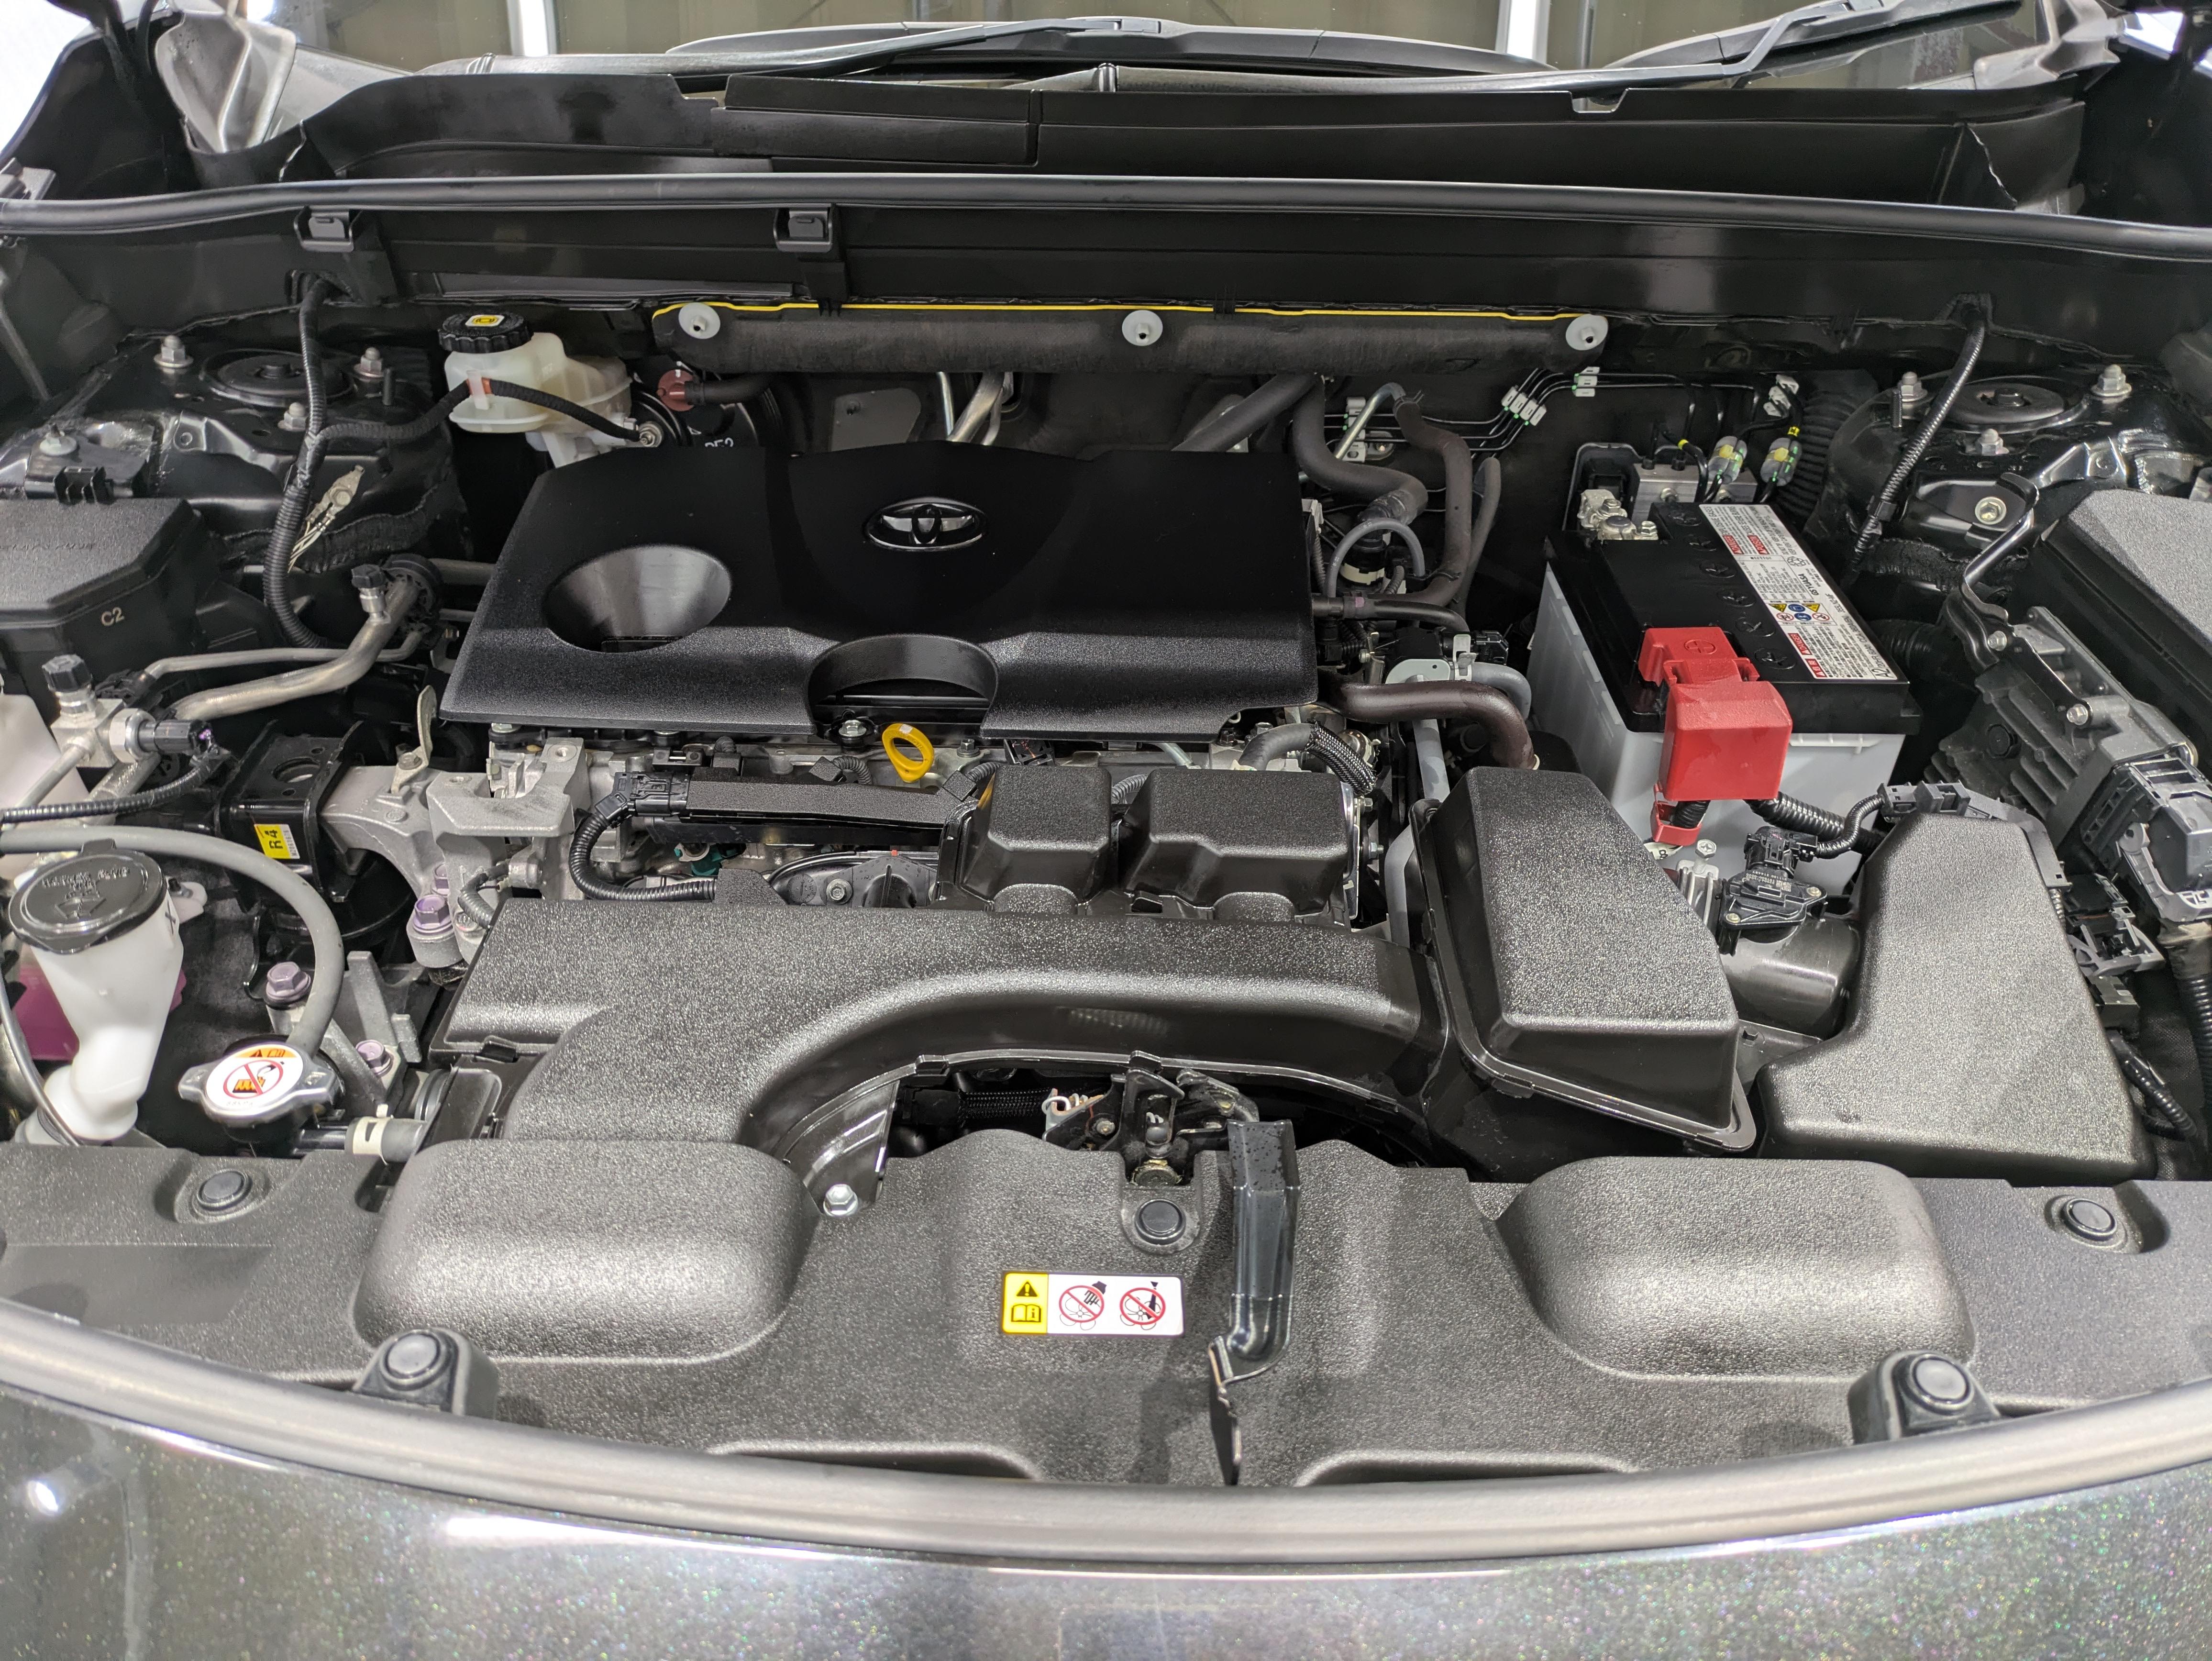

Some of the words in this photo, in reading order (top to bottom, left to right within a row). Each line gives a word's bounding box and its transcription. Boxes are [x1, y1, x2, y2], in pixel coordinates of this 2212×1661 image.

[1796, 573, 1815, 589] YUASA
[101, 607, 125, 626] C2
[1870, 668, 1894, 677] A2
[264, 830, 283, 849] R4
